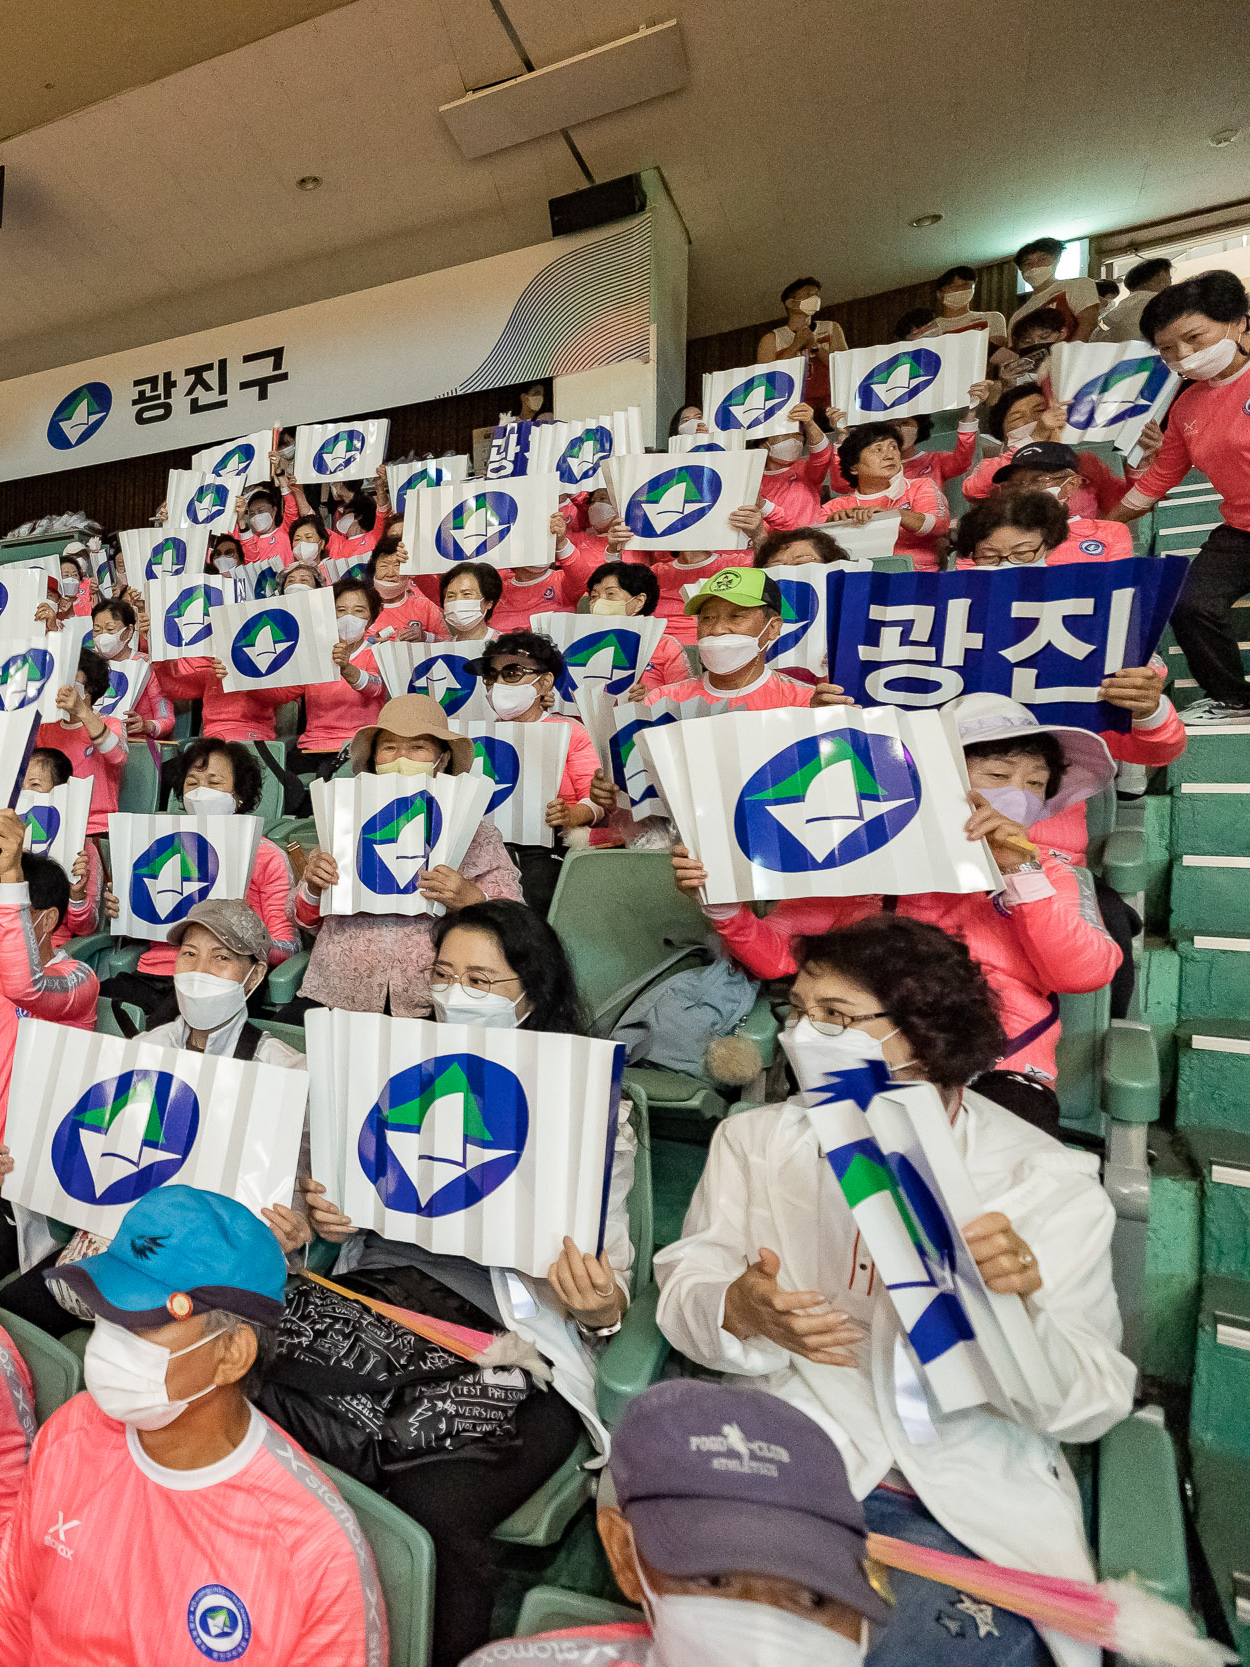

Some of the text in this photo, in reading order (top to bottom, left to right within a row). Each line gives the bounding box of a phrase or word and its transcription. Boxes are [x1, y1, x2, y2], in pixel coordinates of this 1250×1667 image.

[131, 345, 289, 426] 광진구
[857, 587, 1135, 707] 광진
[306, 1474, 366, 1566] stomax
